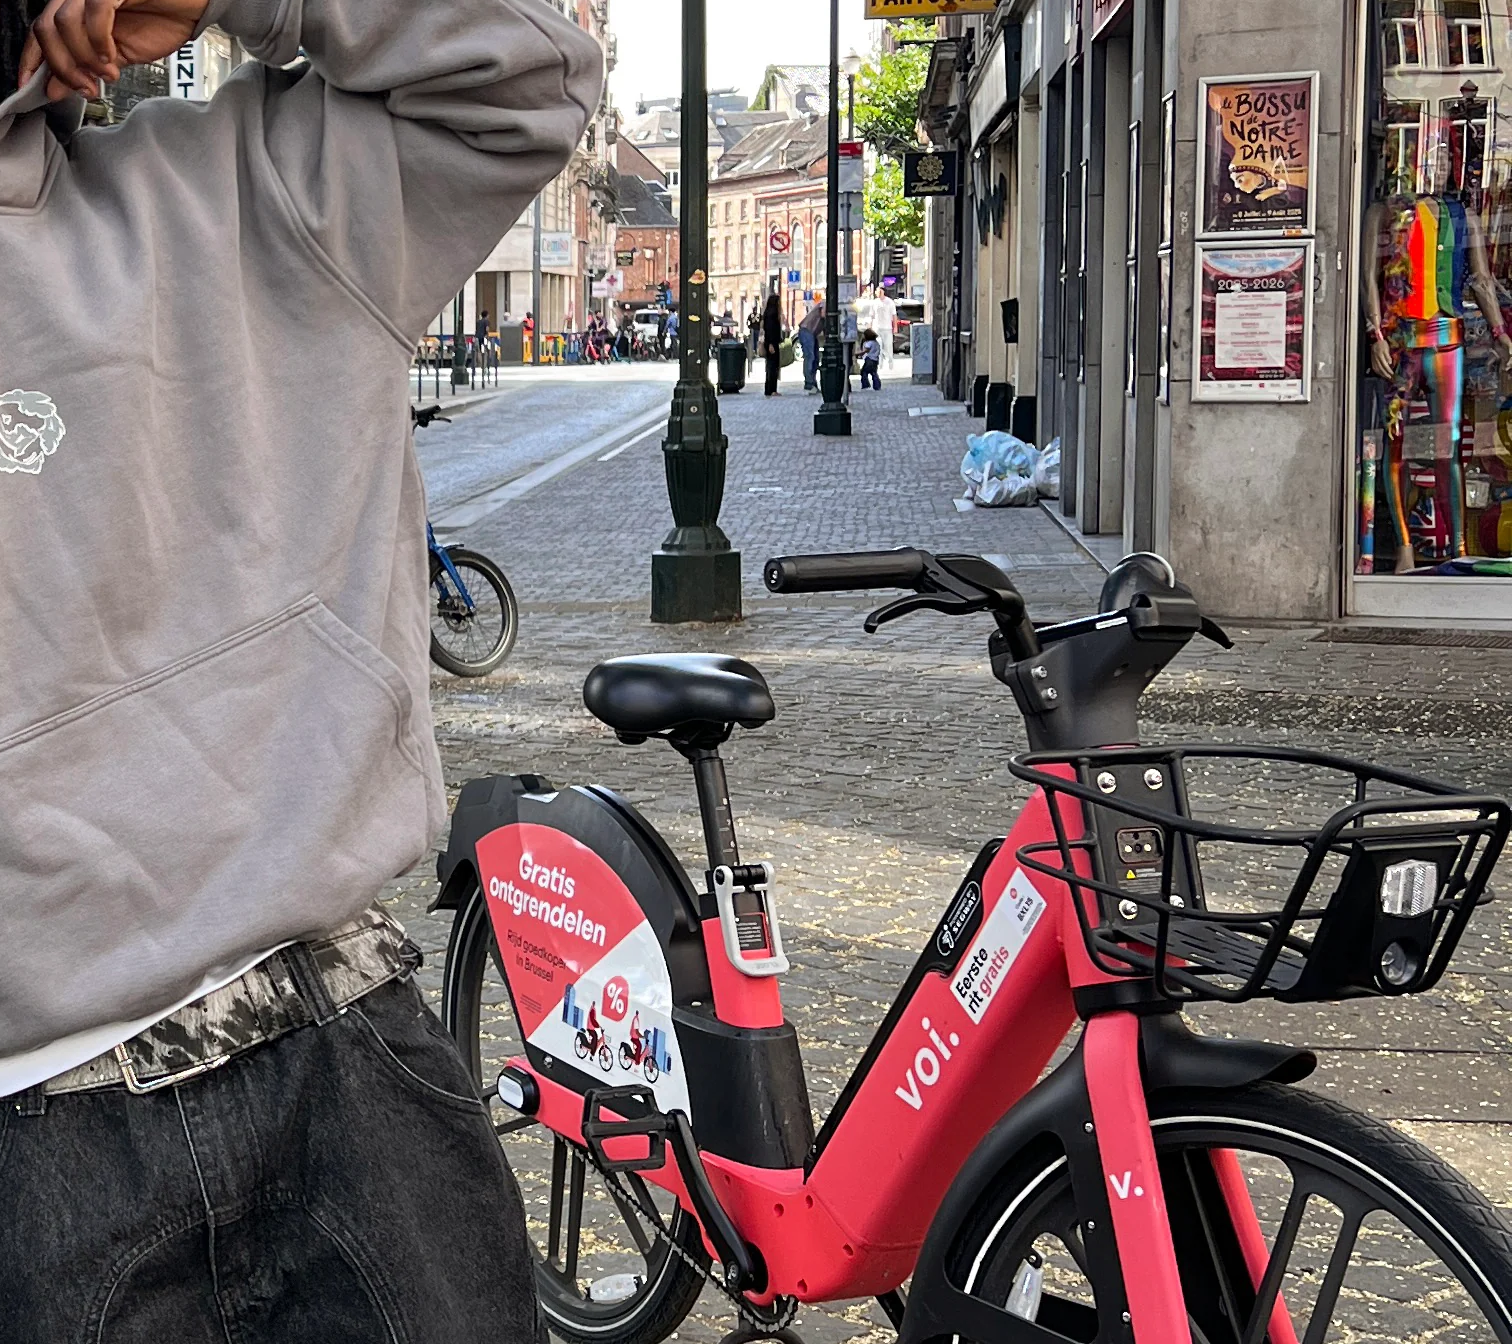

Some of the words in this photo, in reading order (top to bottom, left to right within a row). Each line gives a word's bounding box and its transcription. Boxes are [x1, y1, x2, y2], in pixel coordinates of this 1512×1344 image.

[1234, 91, 1307, 117] BOSSU
[1246, 114, 1259, 125] de
[1229, 118, 1304, 144] NOTRE-
[1240, 138, 1303, 163] DAME
[519, 852, 576, 898] Gratis
[489, 876, 606, 946] ontgrendelen
[507, 929, 522, 948] Rijd
[523, 939, 567, 970] goedkoper
[516, 952, 523, 966] in
[524, 957, 554, 982] Brussel
[956, 948, 988, 998] Eerste
[968, 990, 983, 1014] rit
[979, 946, 1009, 997] gratis
[894, 1016, 960, 1110] voi.
[1109, 1171, 1144, 1199] v.
